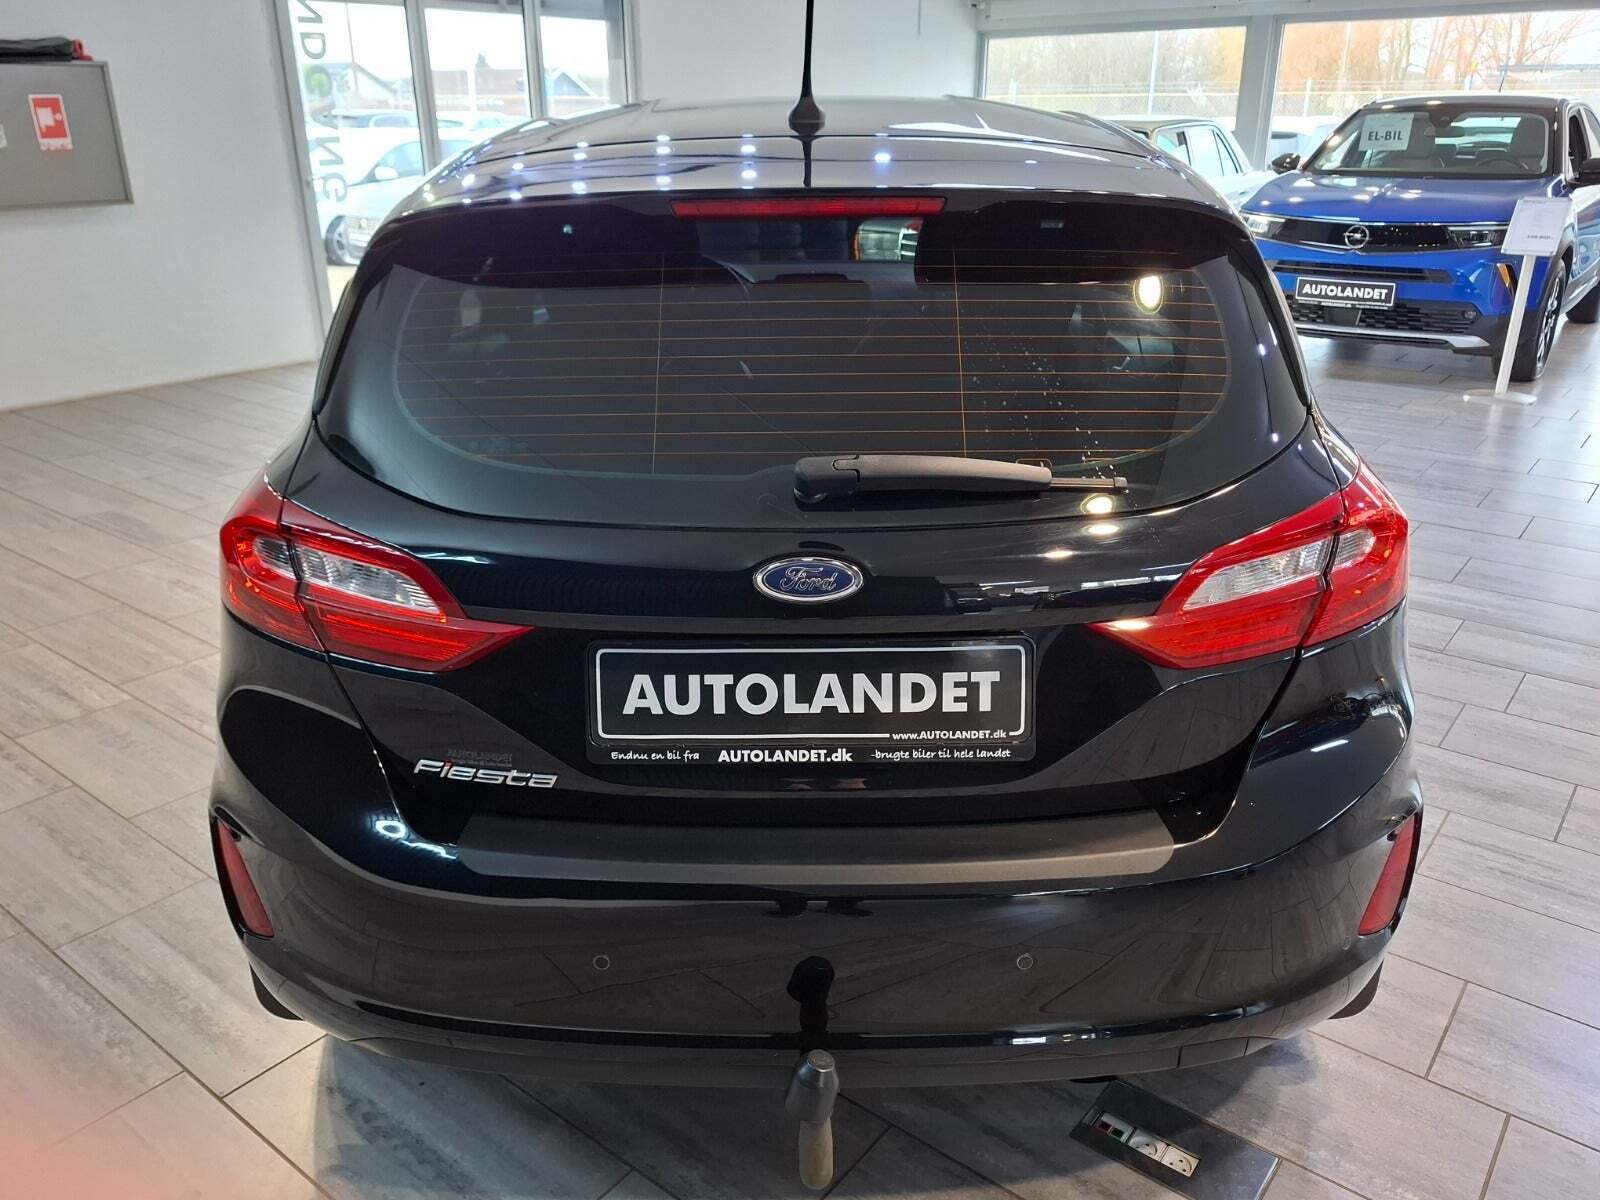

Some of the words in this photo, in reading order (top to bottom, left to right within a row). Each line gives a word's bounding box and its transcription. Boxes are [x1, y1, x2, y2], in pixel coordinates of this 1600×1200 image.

[1367, 130, 1403, 141] EL-BIL
[1302, 283, 1388, 300] AUTOLANDET
[780, 566, 838, 591] Ford
[622, 671, 1001, 715] AUTOLANDET
[892, 730, 1007, 740] www.AUTOLANDET.dk
[611, 750, 649, 760] Endnu
[651, 752, 665, 760] en
[666, 750, 681, 760] bil
[683, 750, 700, 763] fra
[718, 749, 853, 763] AUTOLANDET.dk
[912, 748, 935, 758] biler
[937, 748, 951, 758] til
[954, 748, 974, 758] hele
[976, 748, 1011, 758] landet
[413, 759, 558, 788] Fiesta
